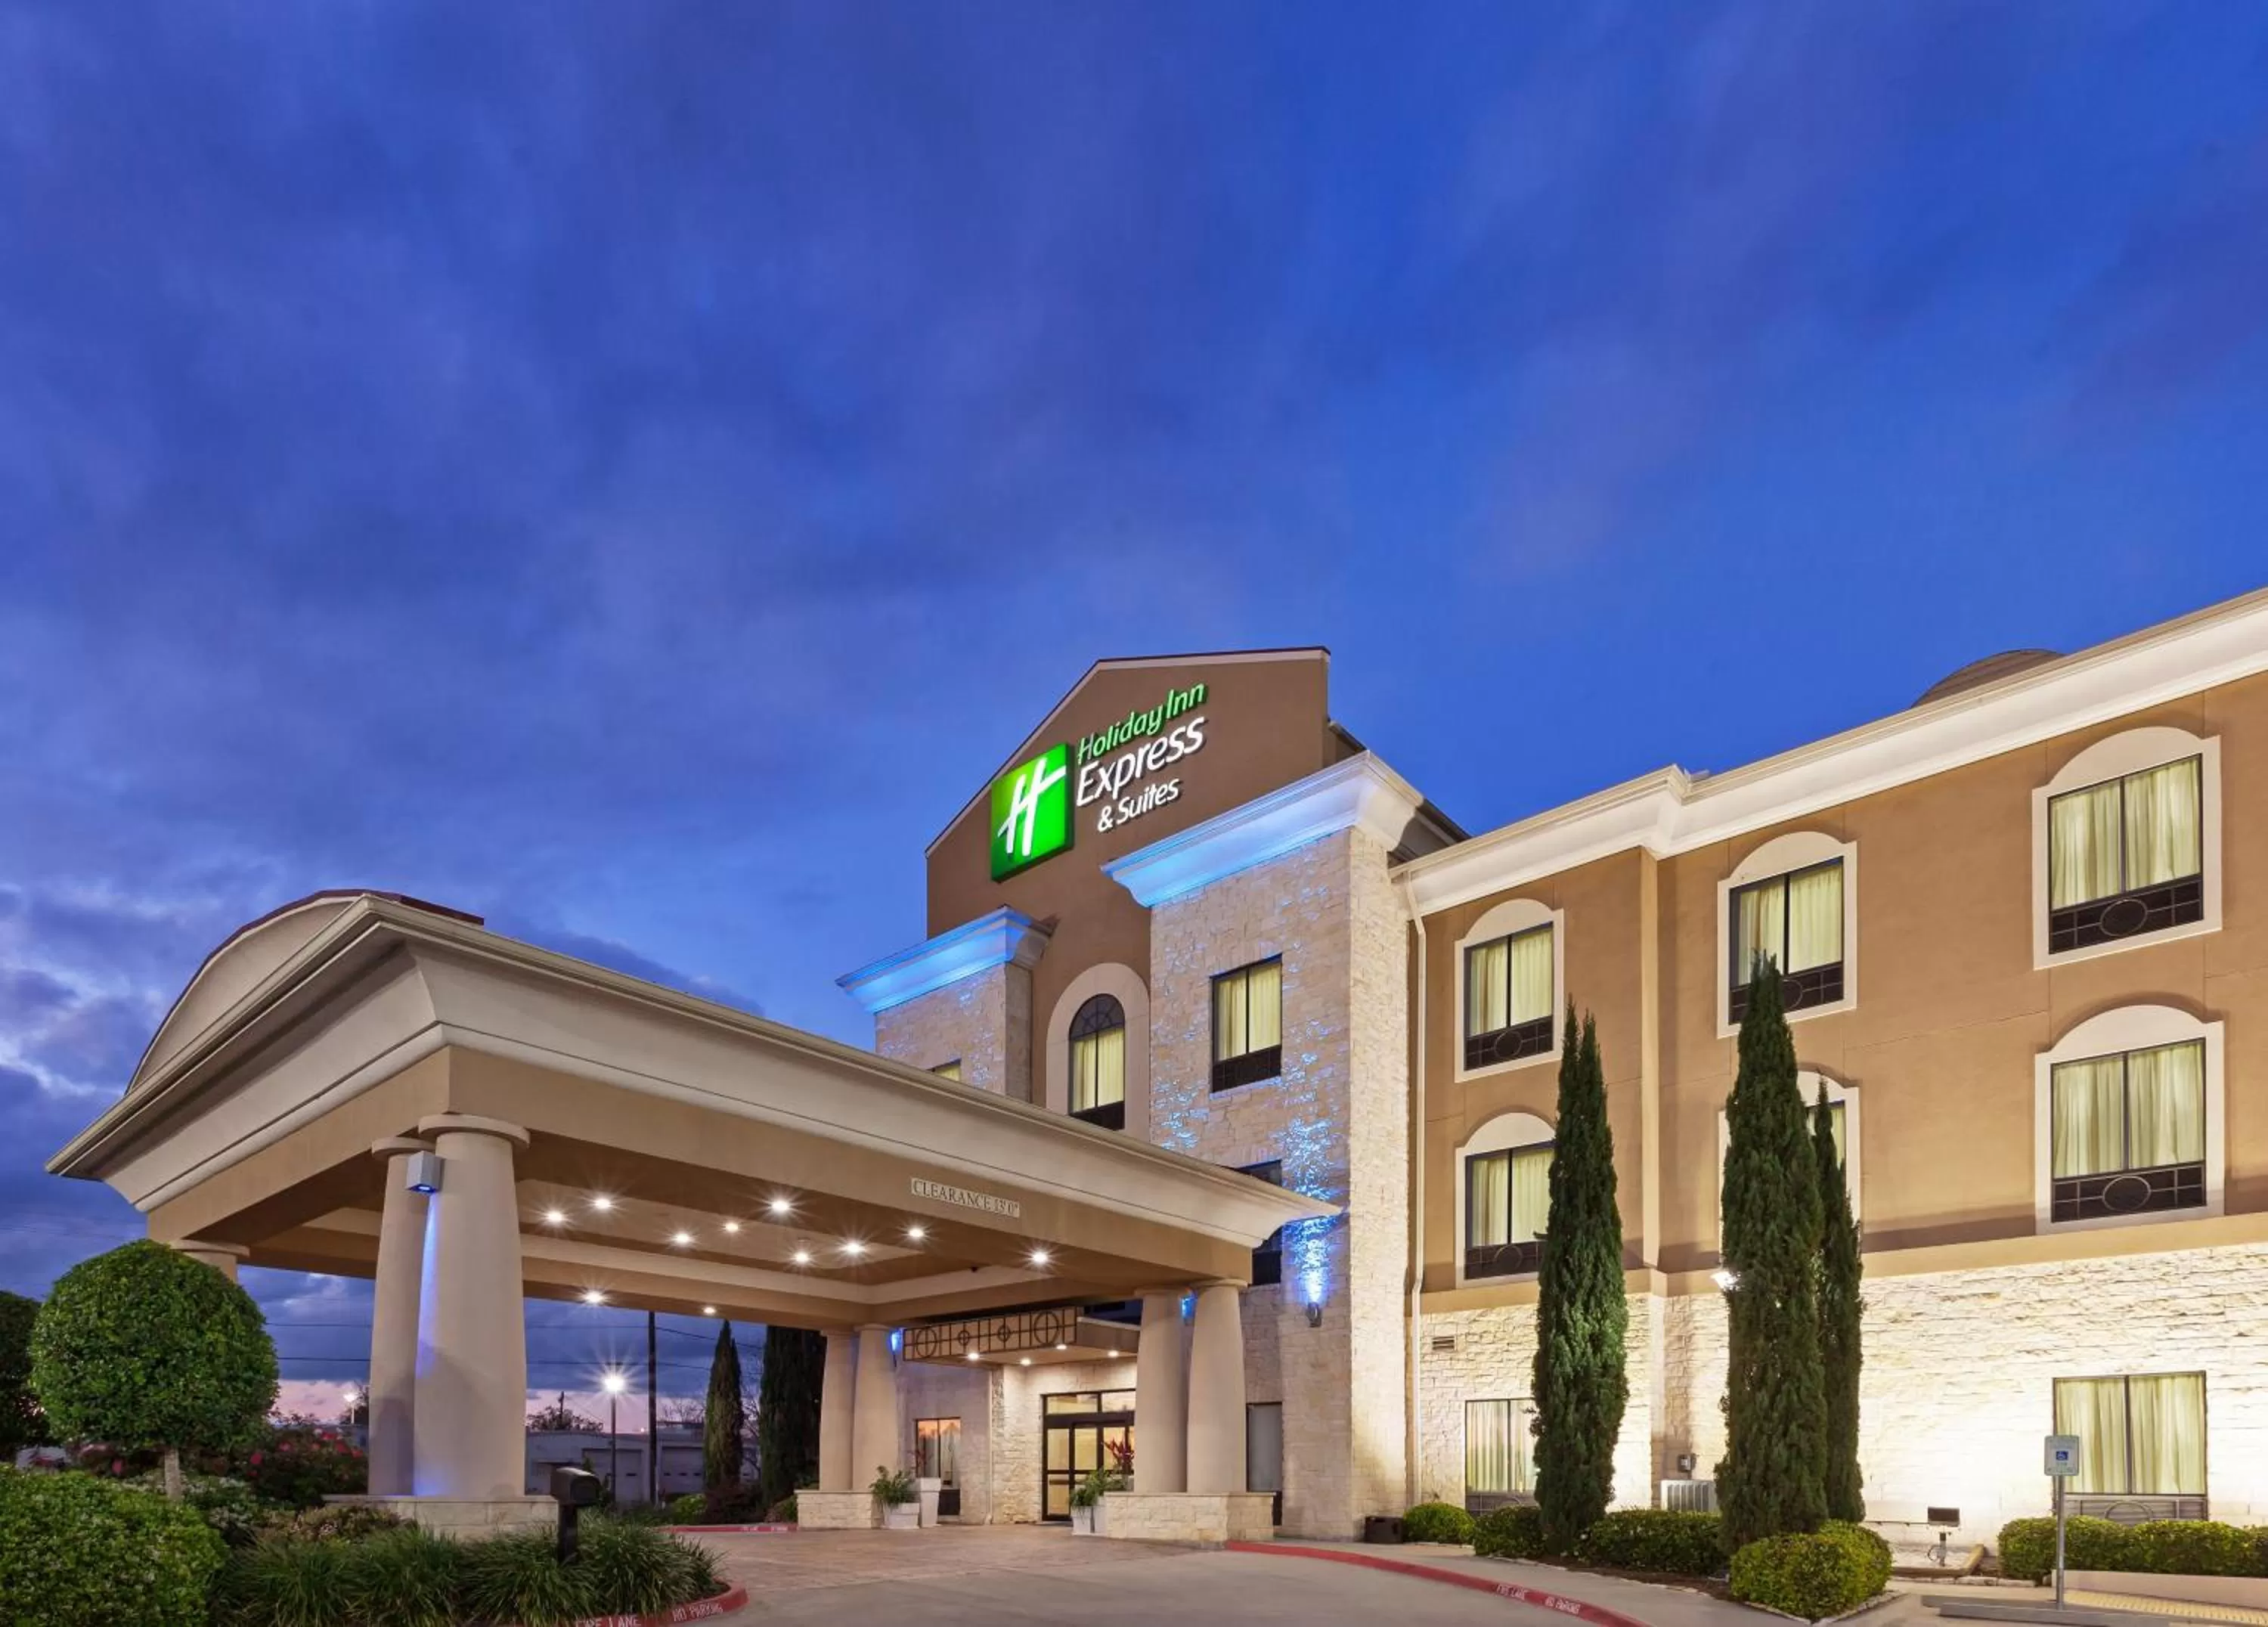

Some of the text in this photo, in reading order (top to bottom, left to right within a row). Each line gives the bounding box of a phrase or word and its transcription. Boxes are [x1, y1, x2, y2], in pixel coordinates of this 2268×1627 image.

[1077, 683, 1204, 765] Holiday Inn
[1077, 716, 1204, 807] Express
[1098, 778, 1180, 832] & Suites
[912, 1179, 991, 1210] CLEARANCE
[672, 1608, 687, 1622] NO
